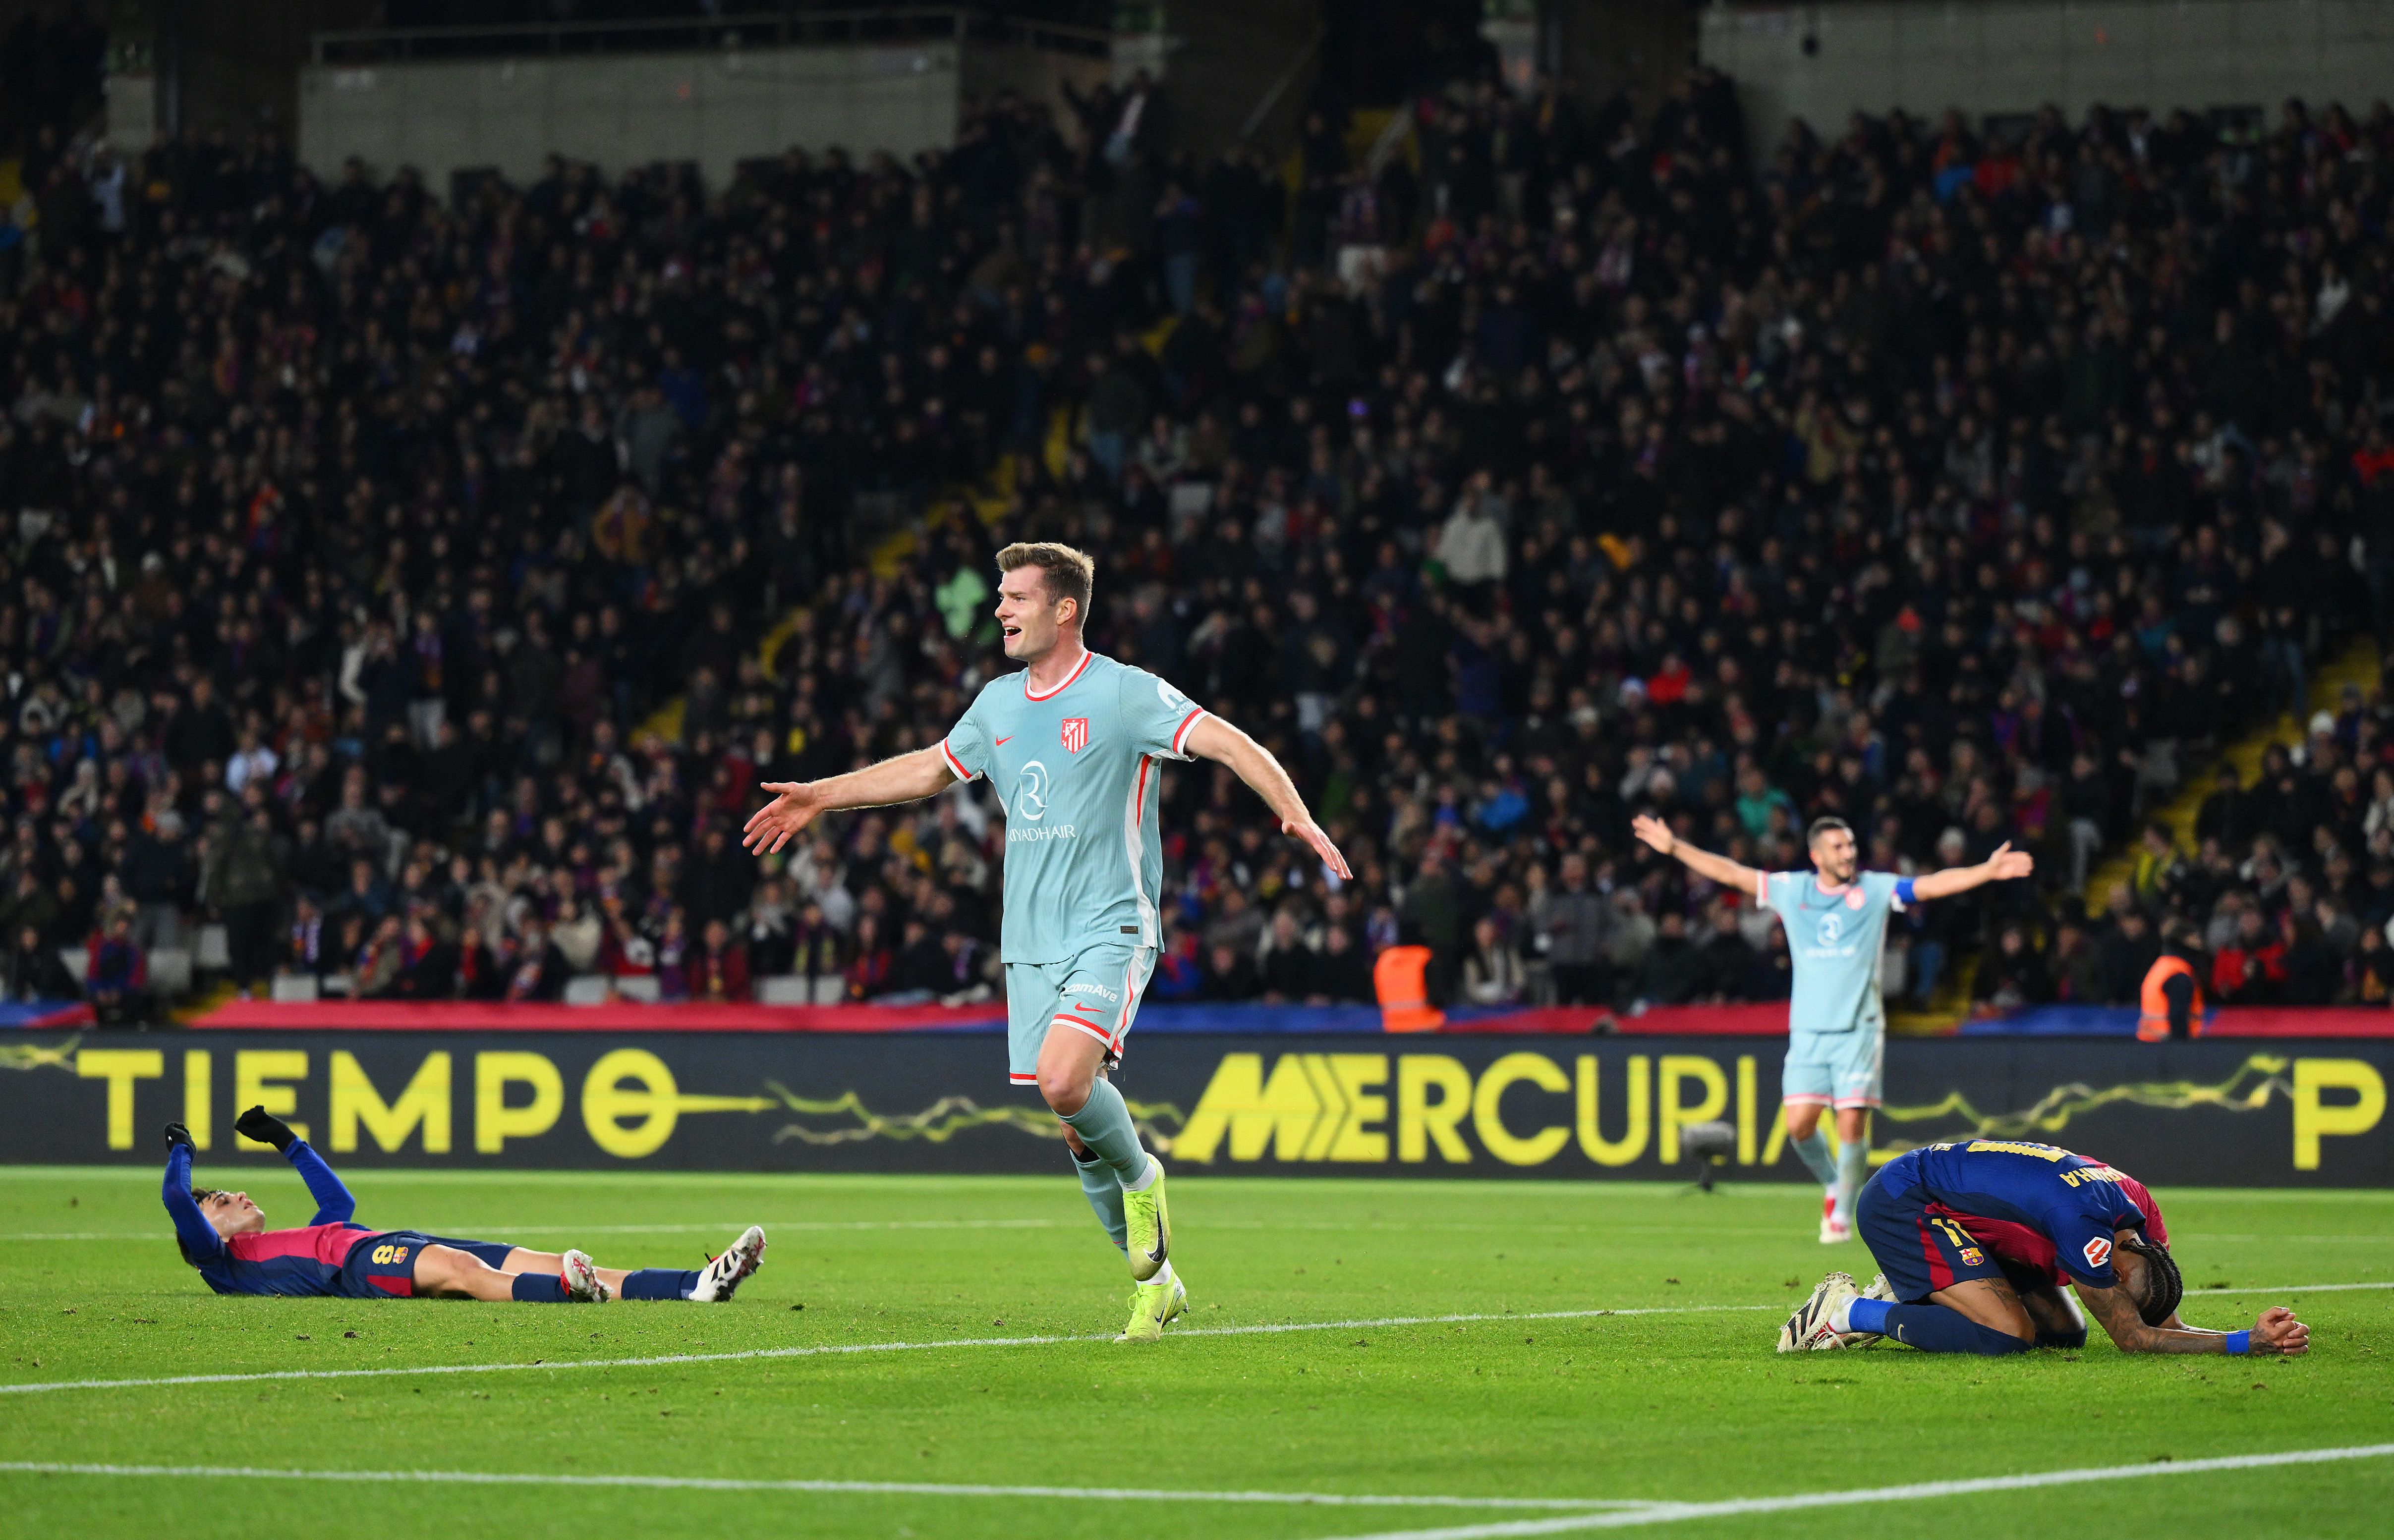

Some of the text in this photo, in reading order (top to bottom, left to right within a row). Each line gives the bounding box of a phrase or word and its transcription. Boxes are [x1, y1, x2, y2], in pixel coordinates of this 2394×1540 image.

[76, 1047, 680, 1158] TIEMPO
[2293, 1057, 2387, 1171] P
[1932, 1218, 1978, 1247] 11
[372, 1245, 395, 1264] 8
